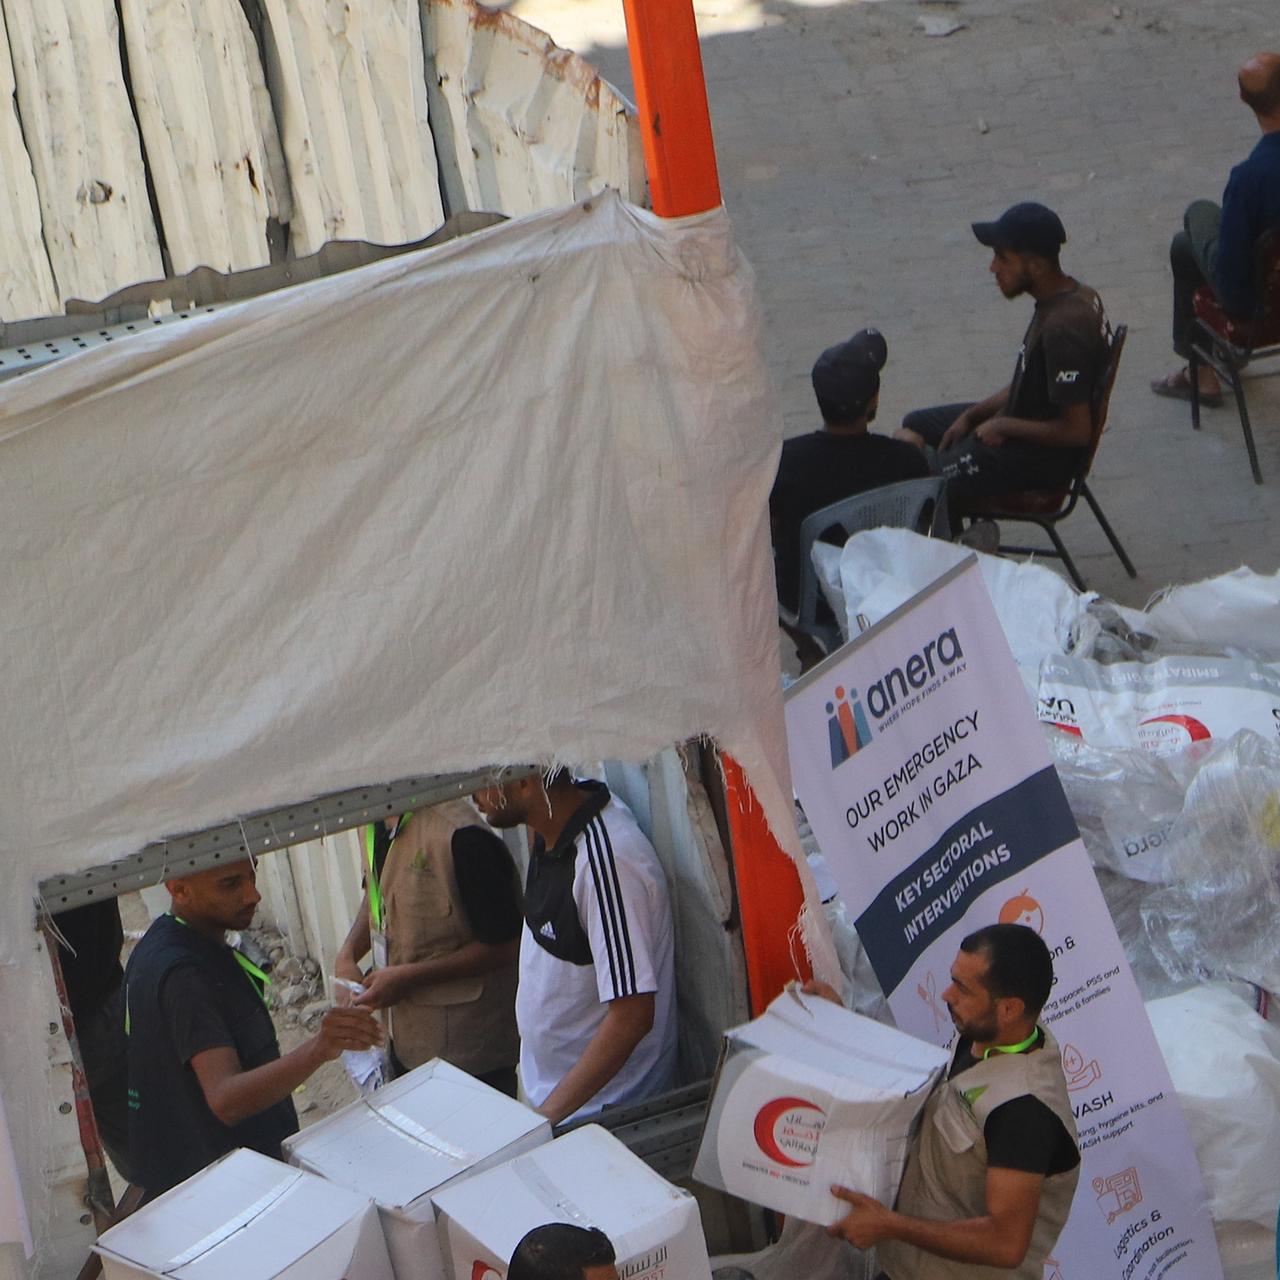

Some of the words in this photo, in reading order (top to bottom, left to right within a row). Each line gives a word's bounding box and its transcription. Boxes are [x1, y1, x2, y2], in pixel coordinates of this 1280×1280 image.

[866, 626, 964, 719] anera
[877, 710, 900, 733] WHERE
[900, 696, 921, 715] HOPE
[921, 681, 942, 699] FINDS
[942, 675, 951, 685] A
[949, 662, 968, 678] WAY
[1143, 666, 1220, 684] EMIRAT
[845, 789, 884, 829] OUR
[883, 709, 980, 800] EMERGENCY
[866, 801, 921, 853] WORK
[918, 786, 934, 814] IN
[933, 753, 983, 797] GAZA
[894, 877, 925, 913] KEY
[923, 821, 994, 888] SECTORAL
[902, 843, 1012, 944] INTERVENTIONS
[1064, 935, 1076, 950] &
[1103, 965, 1120, 979] and
[1043, 1006, 1075, 1026] children
[1081, 985, 1112, 1006] families
[1147, 1091, 1165, 1105] and
[1079, 1136, 1102, 1151] ASH
[1101, 1120, 1135, 1140] support
[1113, 1217, 1149, 1261] Logistics
[1149, 1208, 1163, 1223] &
